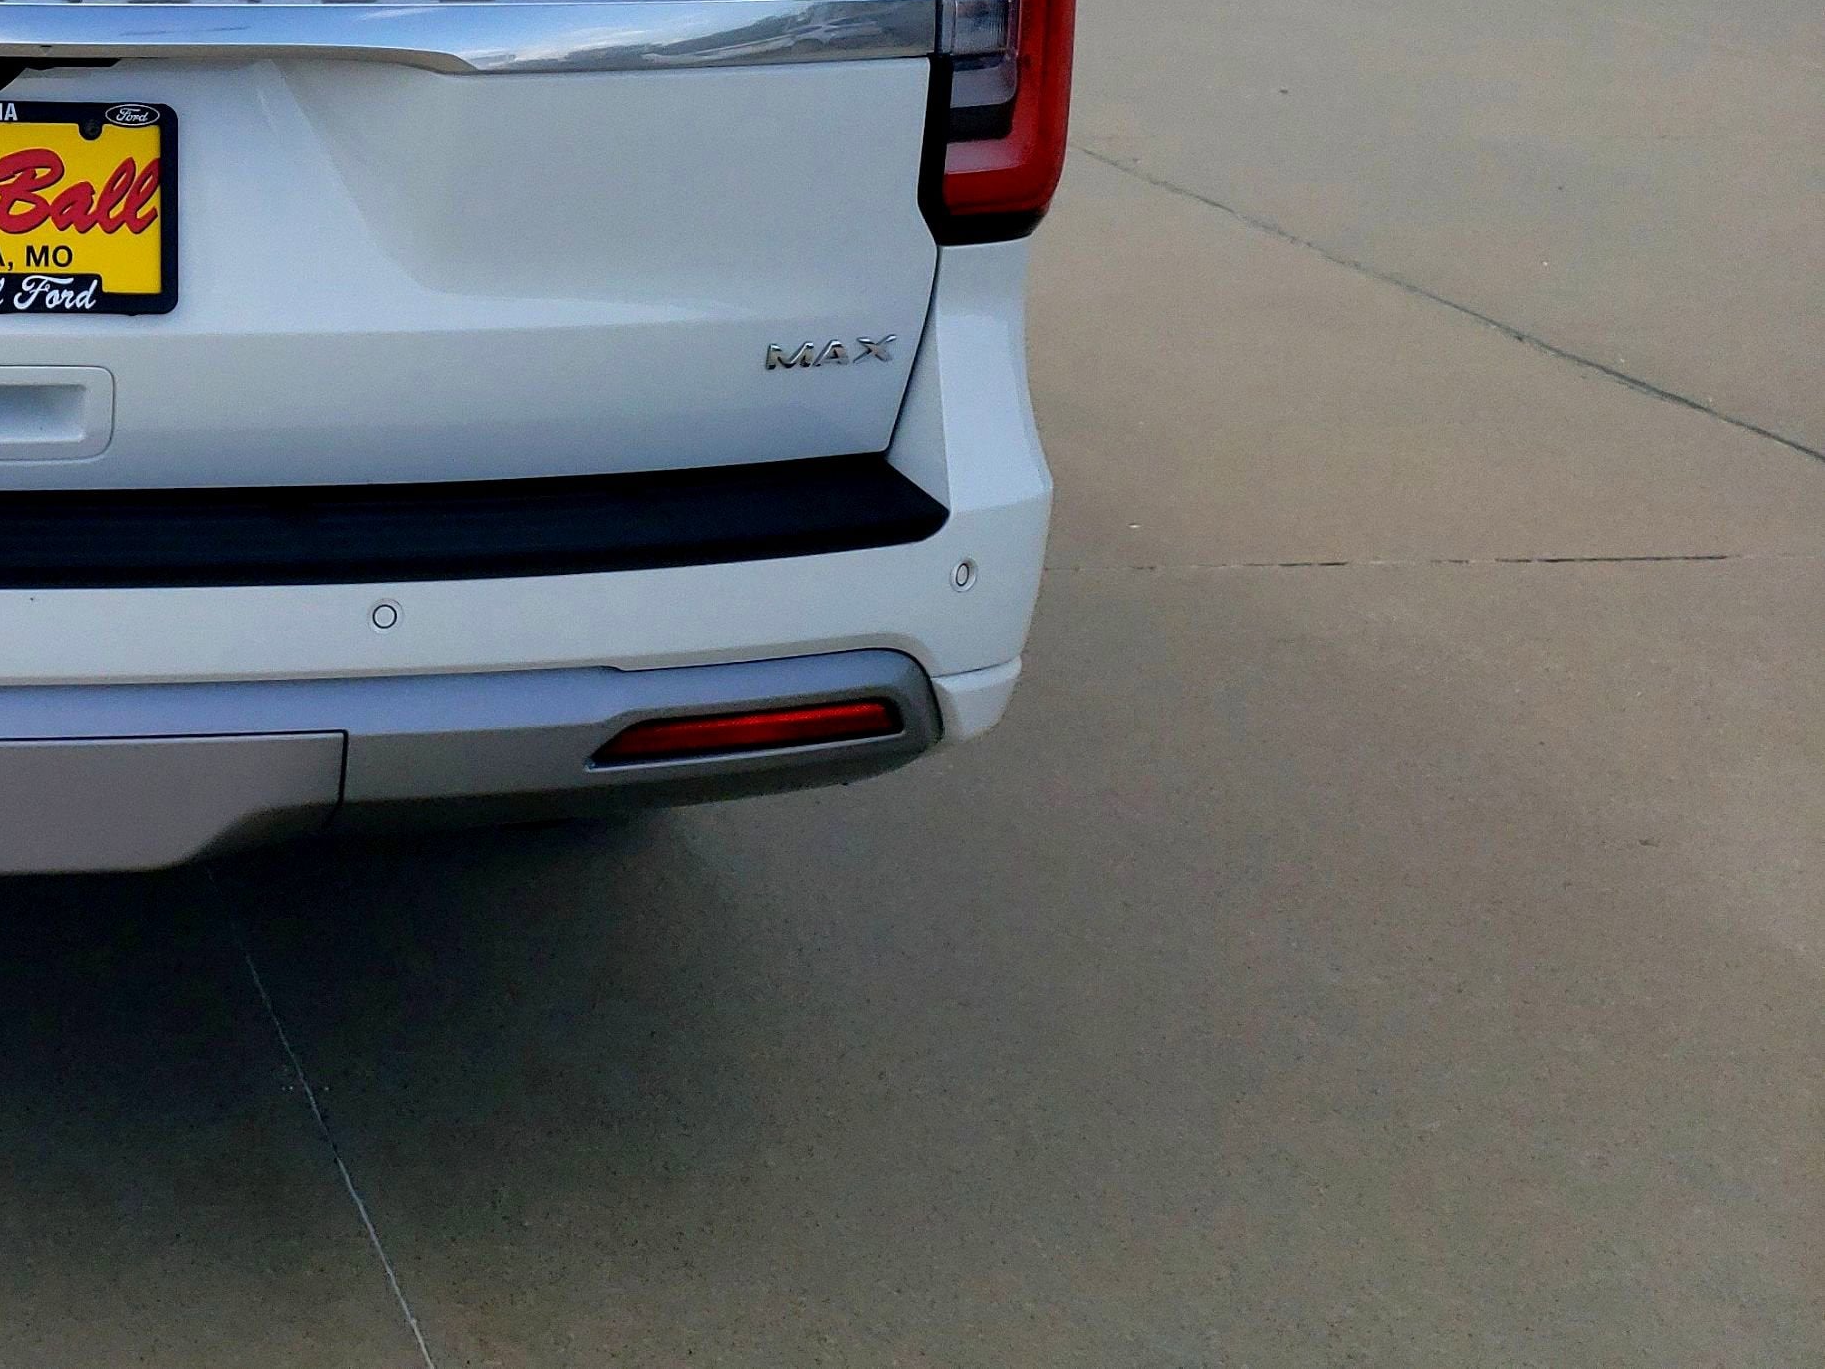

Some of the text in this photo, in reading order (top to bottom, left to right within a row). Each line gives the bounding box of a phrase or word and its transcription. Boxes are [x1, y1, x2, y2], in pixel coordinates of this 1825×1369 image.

[116, 107, 149, 122] Ford
[25, 244, 73, 268] MO
[13, 276, 97, 311] Ford
[765, 334, 897, 370] MAX
